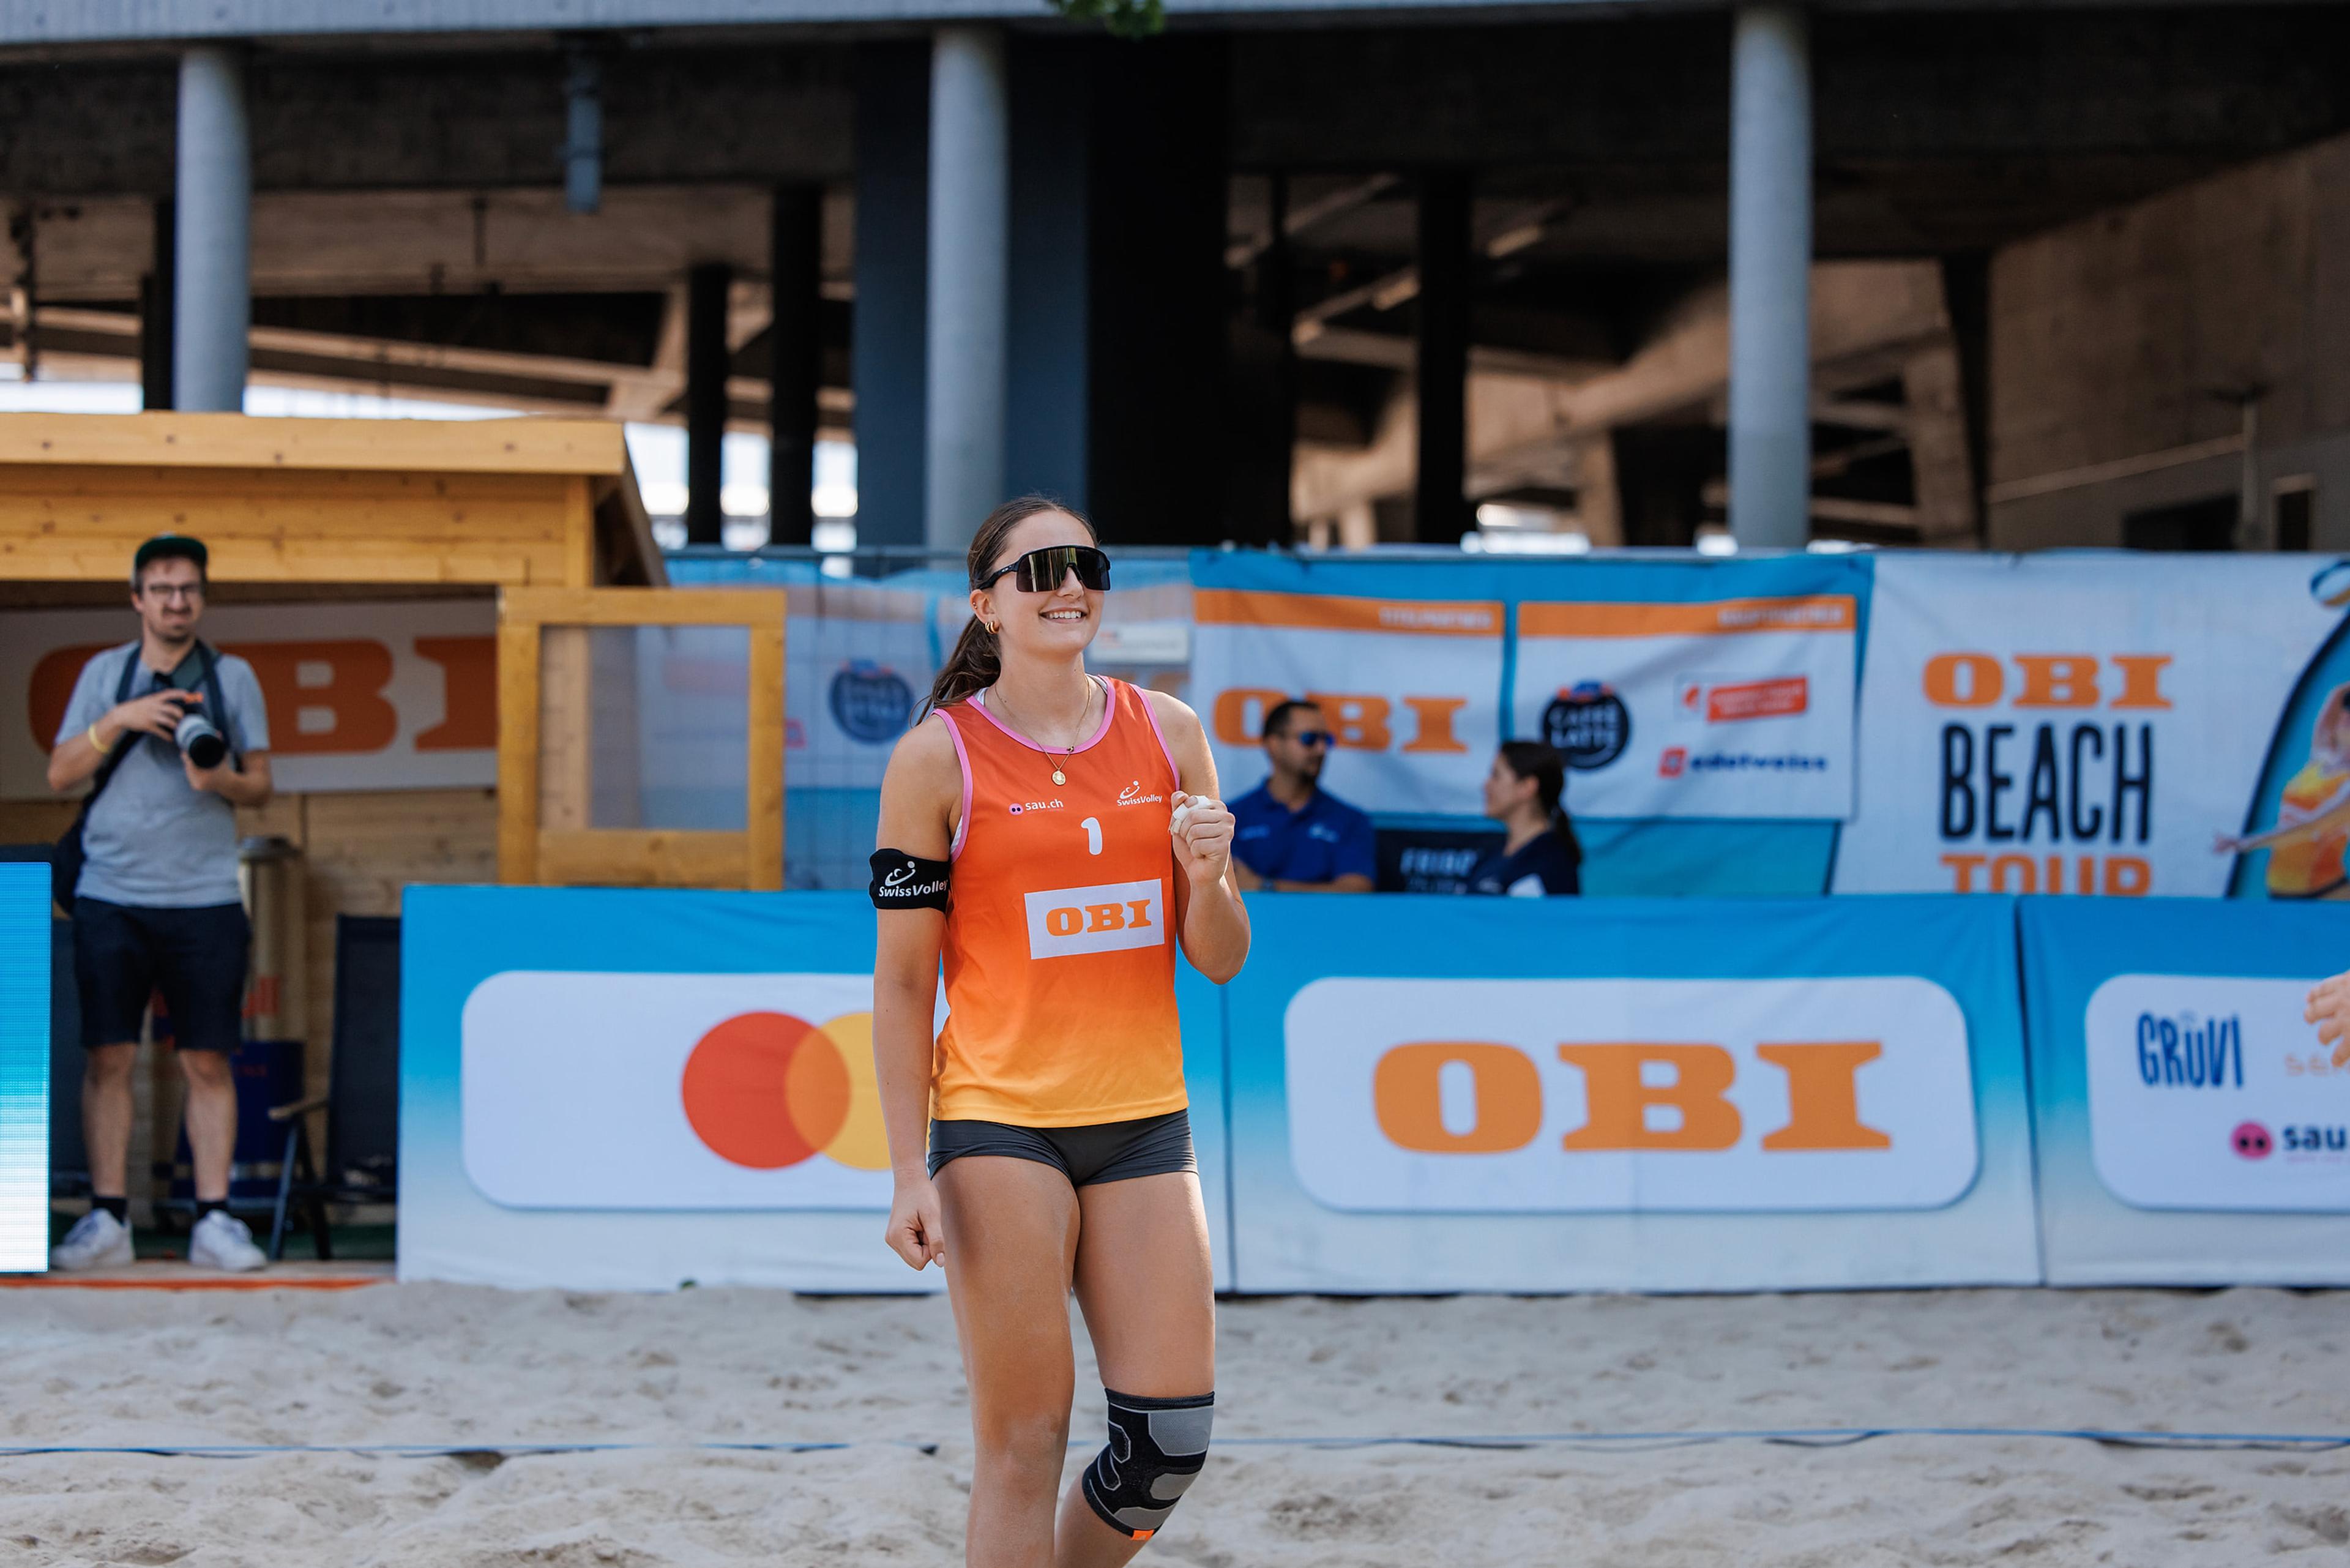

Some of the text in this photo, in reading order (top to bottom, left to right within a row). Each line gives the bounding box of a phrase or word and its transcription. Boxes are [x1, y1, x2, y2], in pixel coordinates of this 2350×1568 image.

[1922, 652, 2174, 710] OBI
[1213, 687, 1469, 754] OBI
[1024, 799, 1064, 811] sau.ch
[1117, 794, 1163, 806] SwissVolley
[1940, 720, 2152, 843] BEACH
[1081, 817, 1102, 856] 1
[1046, 899, 1152, 936] OBI
[1372, 1040, 1893, 1155] OBI
